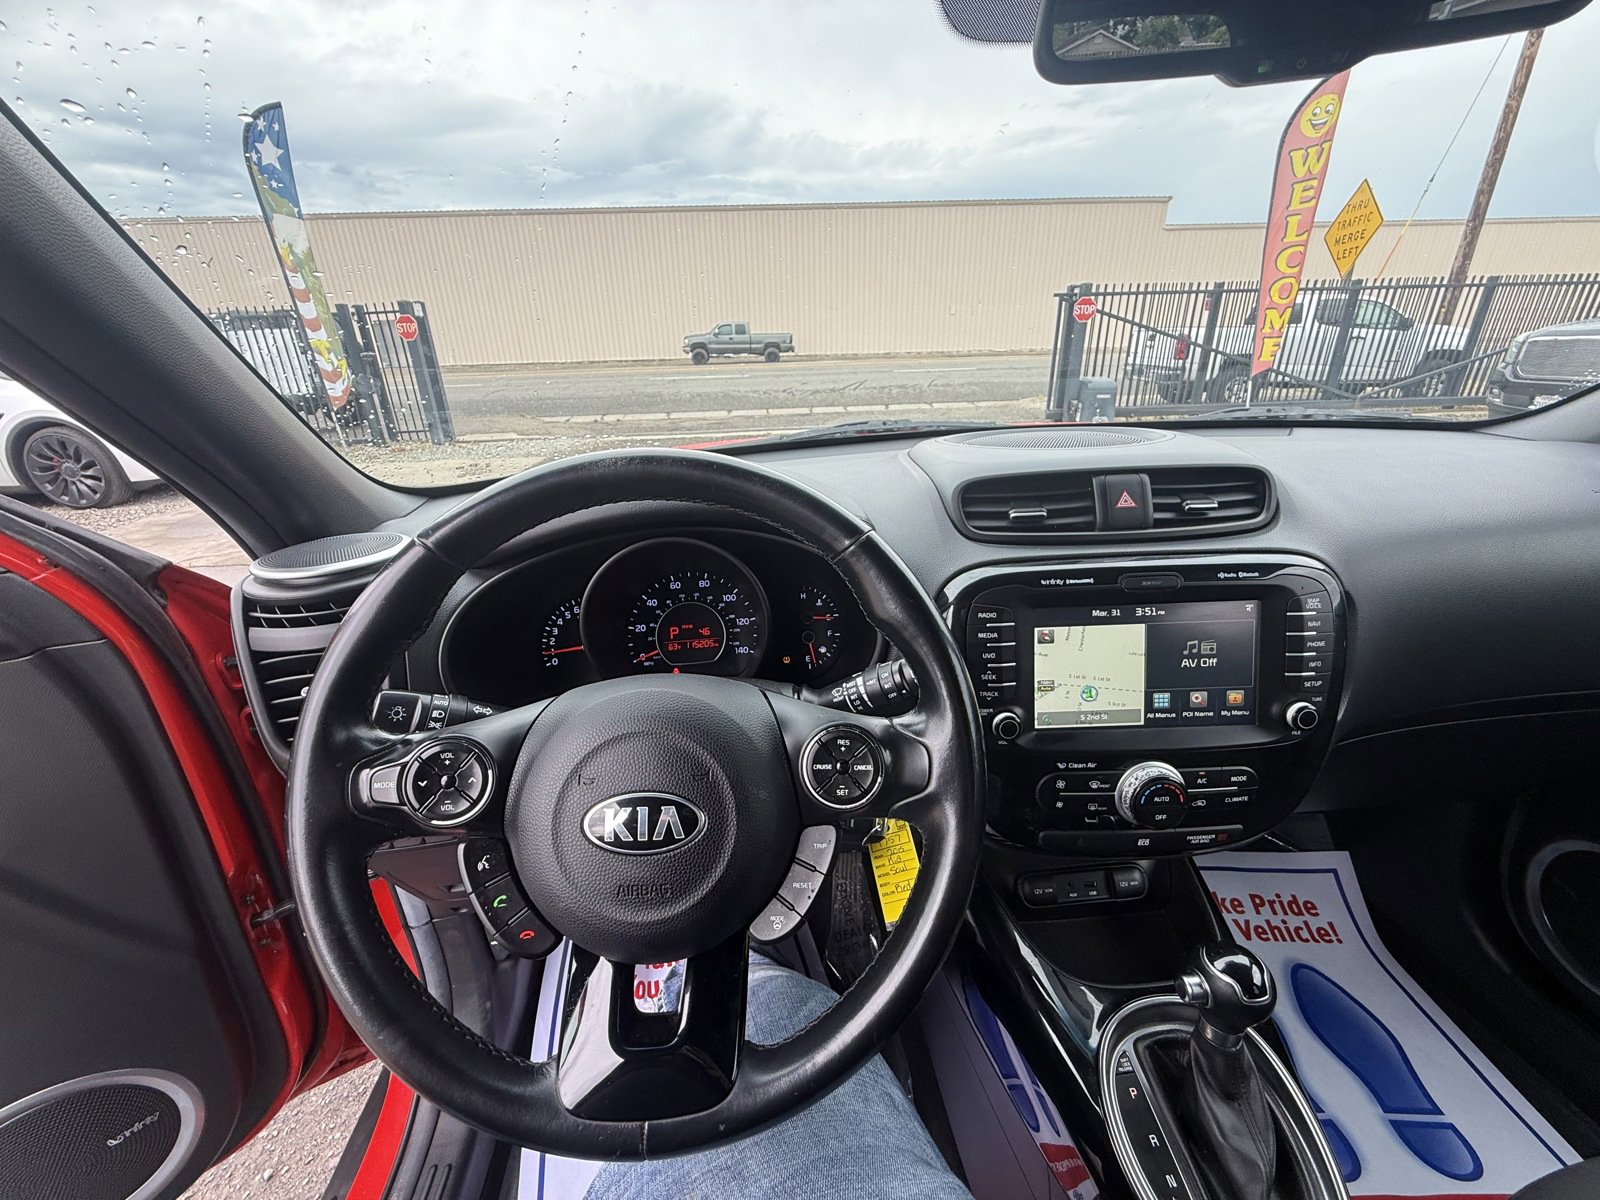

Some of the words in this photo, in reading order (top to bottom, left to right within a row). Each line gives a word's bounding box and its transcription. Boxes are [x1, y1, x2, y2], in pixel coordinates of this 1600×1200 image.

[1346, 198, 1370, 214] THRU
[1337, 212, 1373, 232] TRAFFIC
[1334, 229, 1366, 247] MERGE
[1259, 139, 1332, 362] WELCOME
[1337, 246, 1359, 260] LEFT
[1074, 304, 1096, 315] STOP
[396, 323, 417, 334] STOP
[1136, 608, 1157, 616] 3:51
[670, 627, 679, 639] P
[699, 627, 710, 635] 46
[1181, 659, 1197, 668] AV
[1201, 658, 1217, 667] Off
[603, 806, 684, 842] KIA
[1248, 893, 1320, 917] Pride
[1232, 918, 1344, 944] Vehicle!
[1129, 1088, 1138, 1099] P
[1149, 1134, 1159, 1147] R
[1166, 1174, 1177, 1188] N
